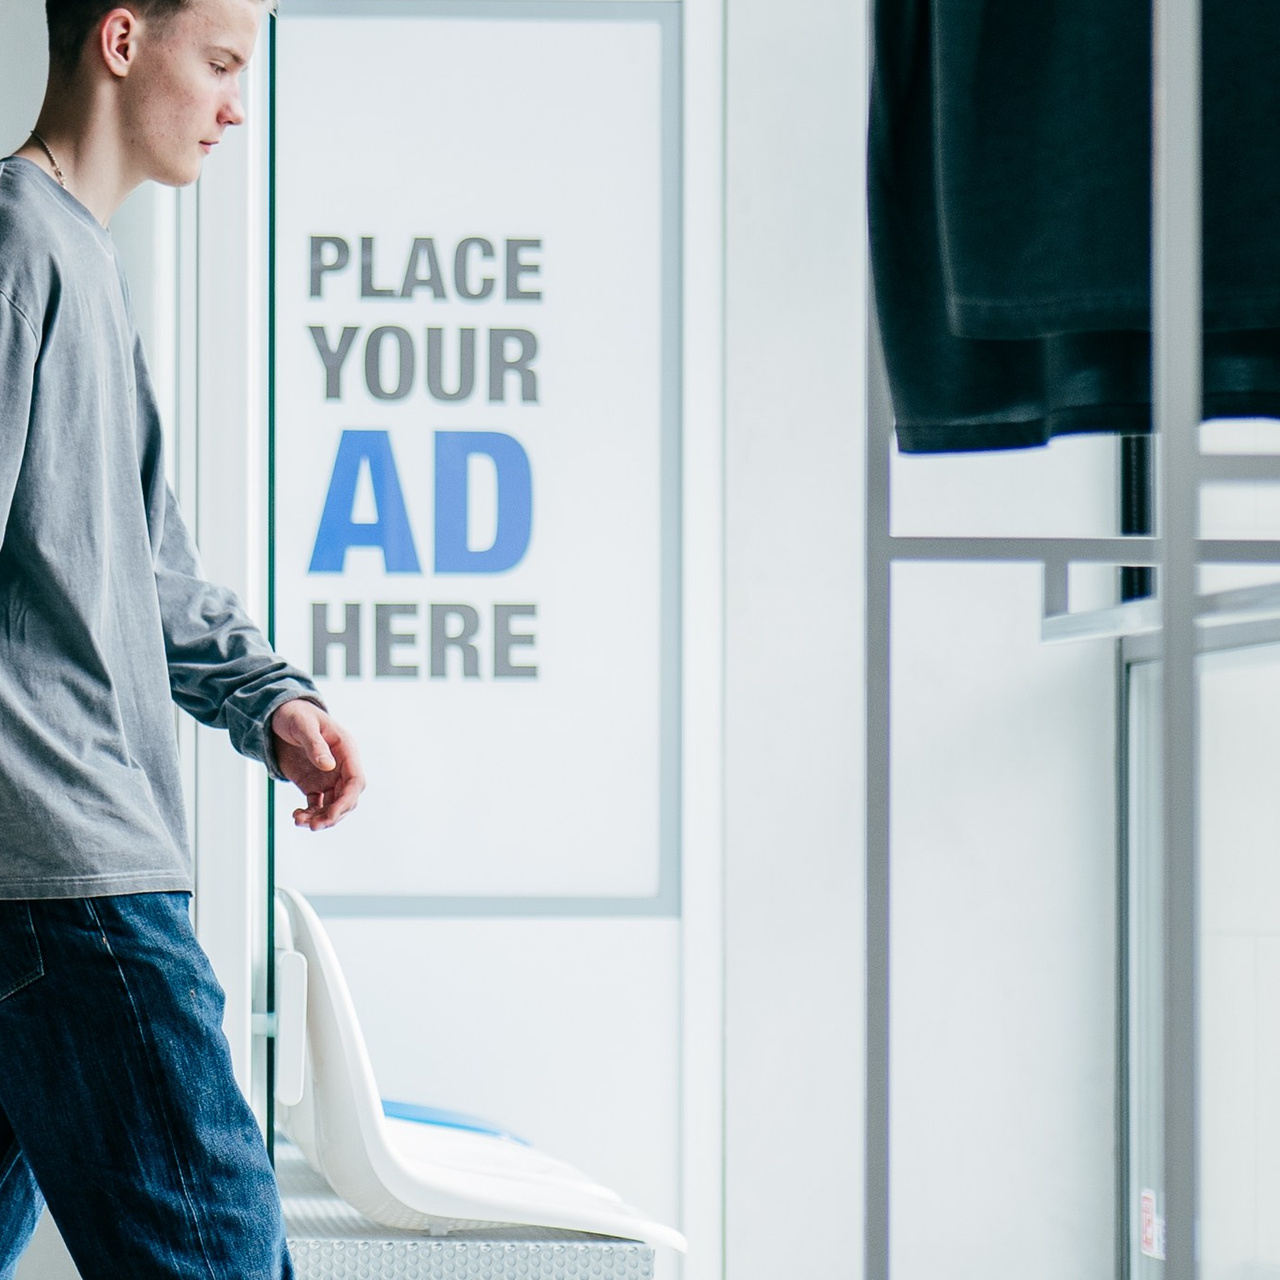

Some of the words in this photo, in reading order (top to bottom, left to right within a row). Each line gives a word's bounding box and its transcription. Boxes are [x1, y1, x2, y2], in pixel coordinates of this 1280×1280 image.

[309, 235, 542, 302] PLACE
[307, 325, 539, 403] YOUR
[308, 429, 533, 575] AD
[311, 603, 538, 678] HERE
